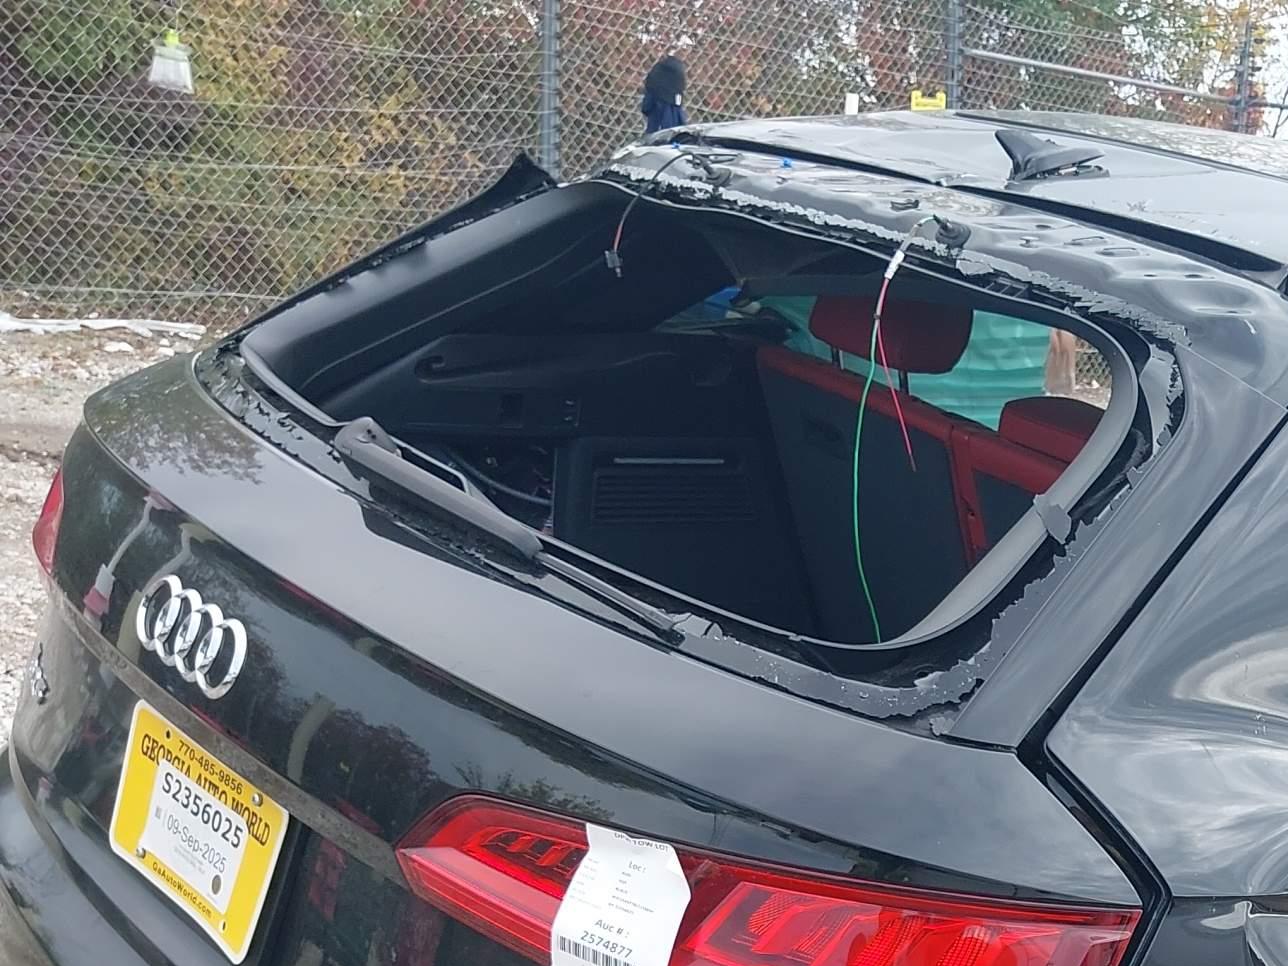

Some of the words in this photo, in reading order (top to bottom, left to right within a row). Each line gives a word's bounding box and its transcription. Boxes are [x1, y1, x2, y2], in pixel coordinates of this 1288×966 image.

[178, 740, 244, 795] 770-485-9856
[161, 771, 244, 849] S2356025
[231, 796, 270, 847] WORLD
[167, 814, 227, 873] 09-Sep-2025
[580, 930, 633, 958] 2574877
